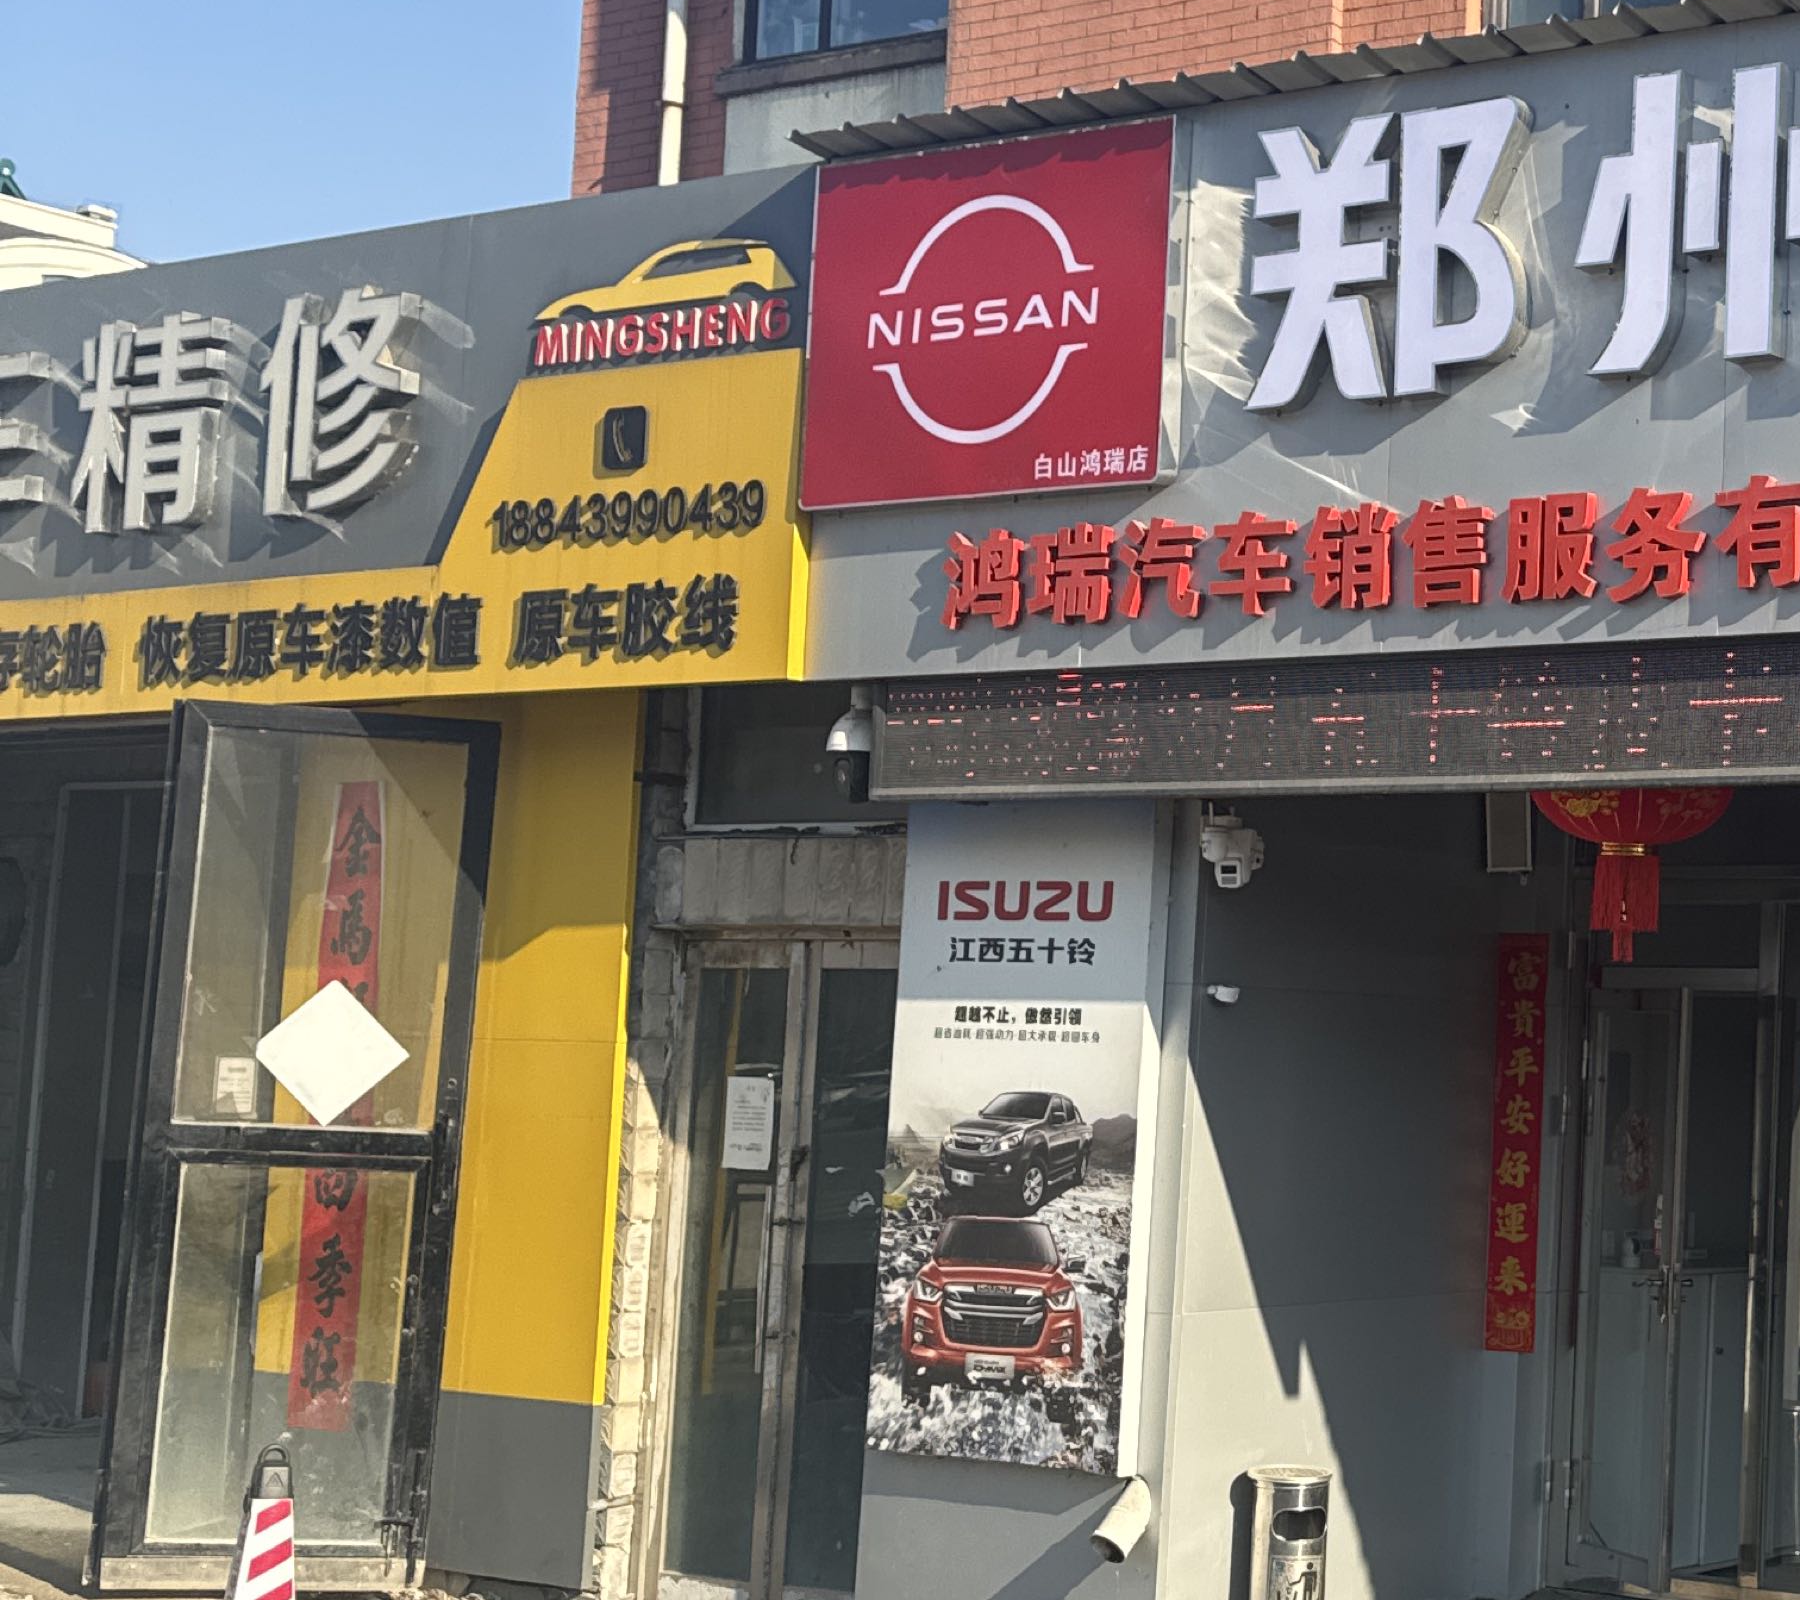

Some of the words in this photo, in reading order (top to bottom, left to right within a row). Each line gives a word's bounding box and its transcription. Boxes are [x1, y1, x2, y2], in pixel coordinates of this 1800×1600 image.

[533, 297, 791, 367] MINGSHENG
[867, 286, 1099, 349] NISSAN
[1034, 444, 1149, 480] 白山鸿瑞店
[493, 479, 765, 547] 18843990439
[141, 592, 483, 690] 恢复原车漆数值
[513, 574, 739, 663] 原车胶线
[937, 880, 1114, 921] ISUZU
[949, 937, 1096, 966] 江西五十铃
